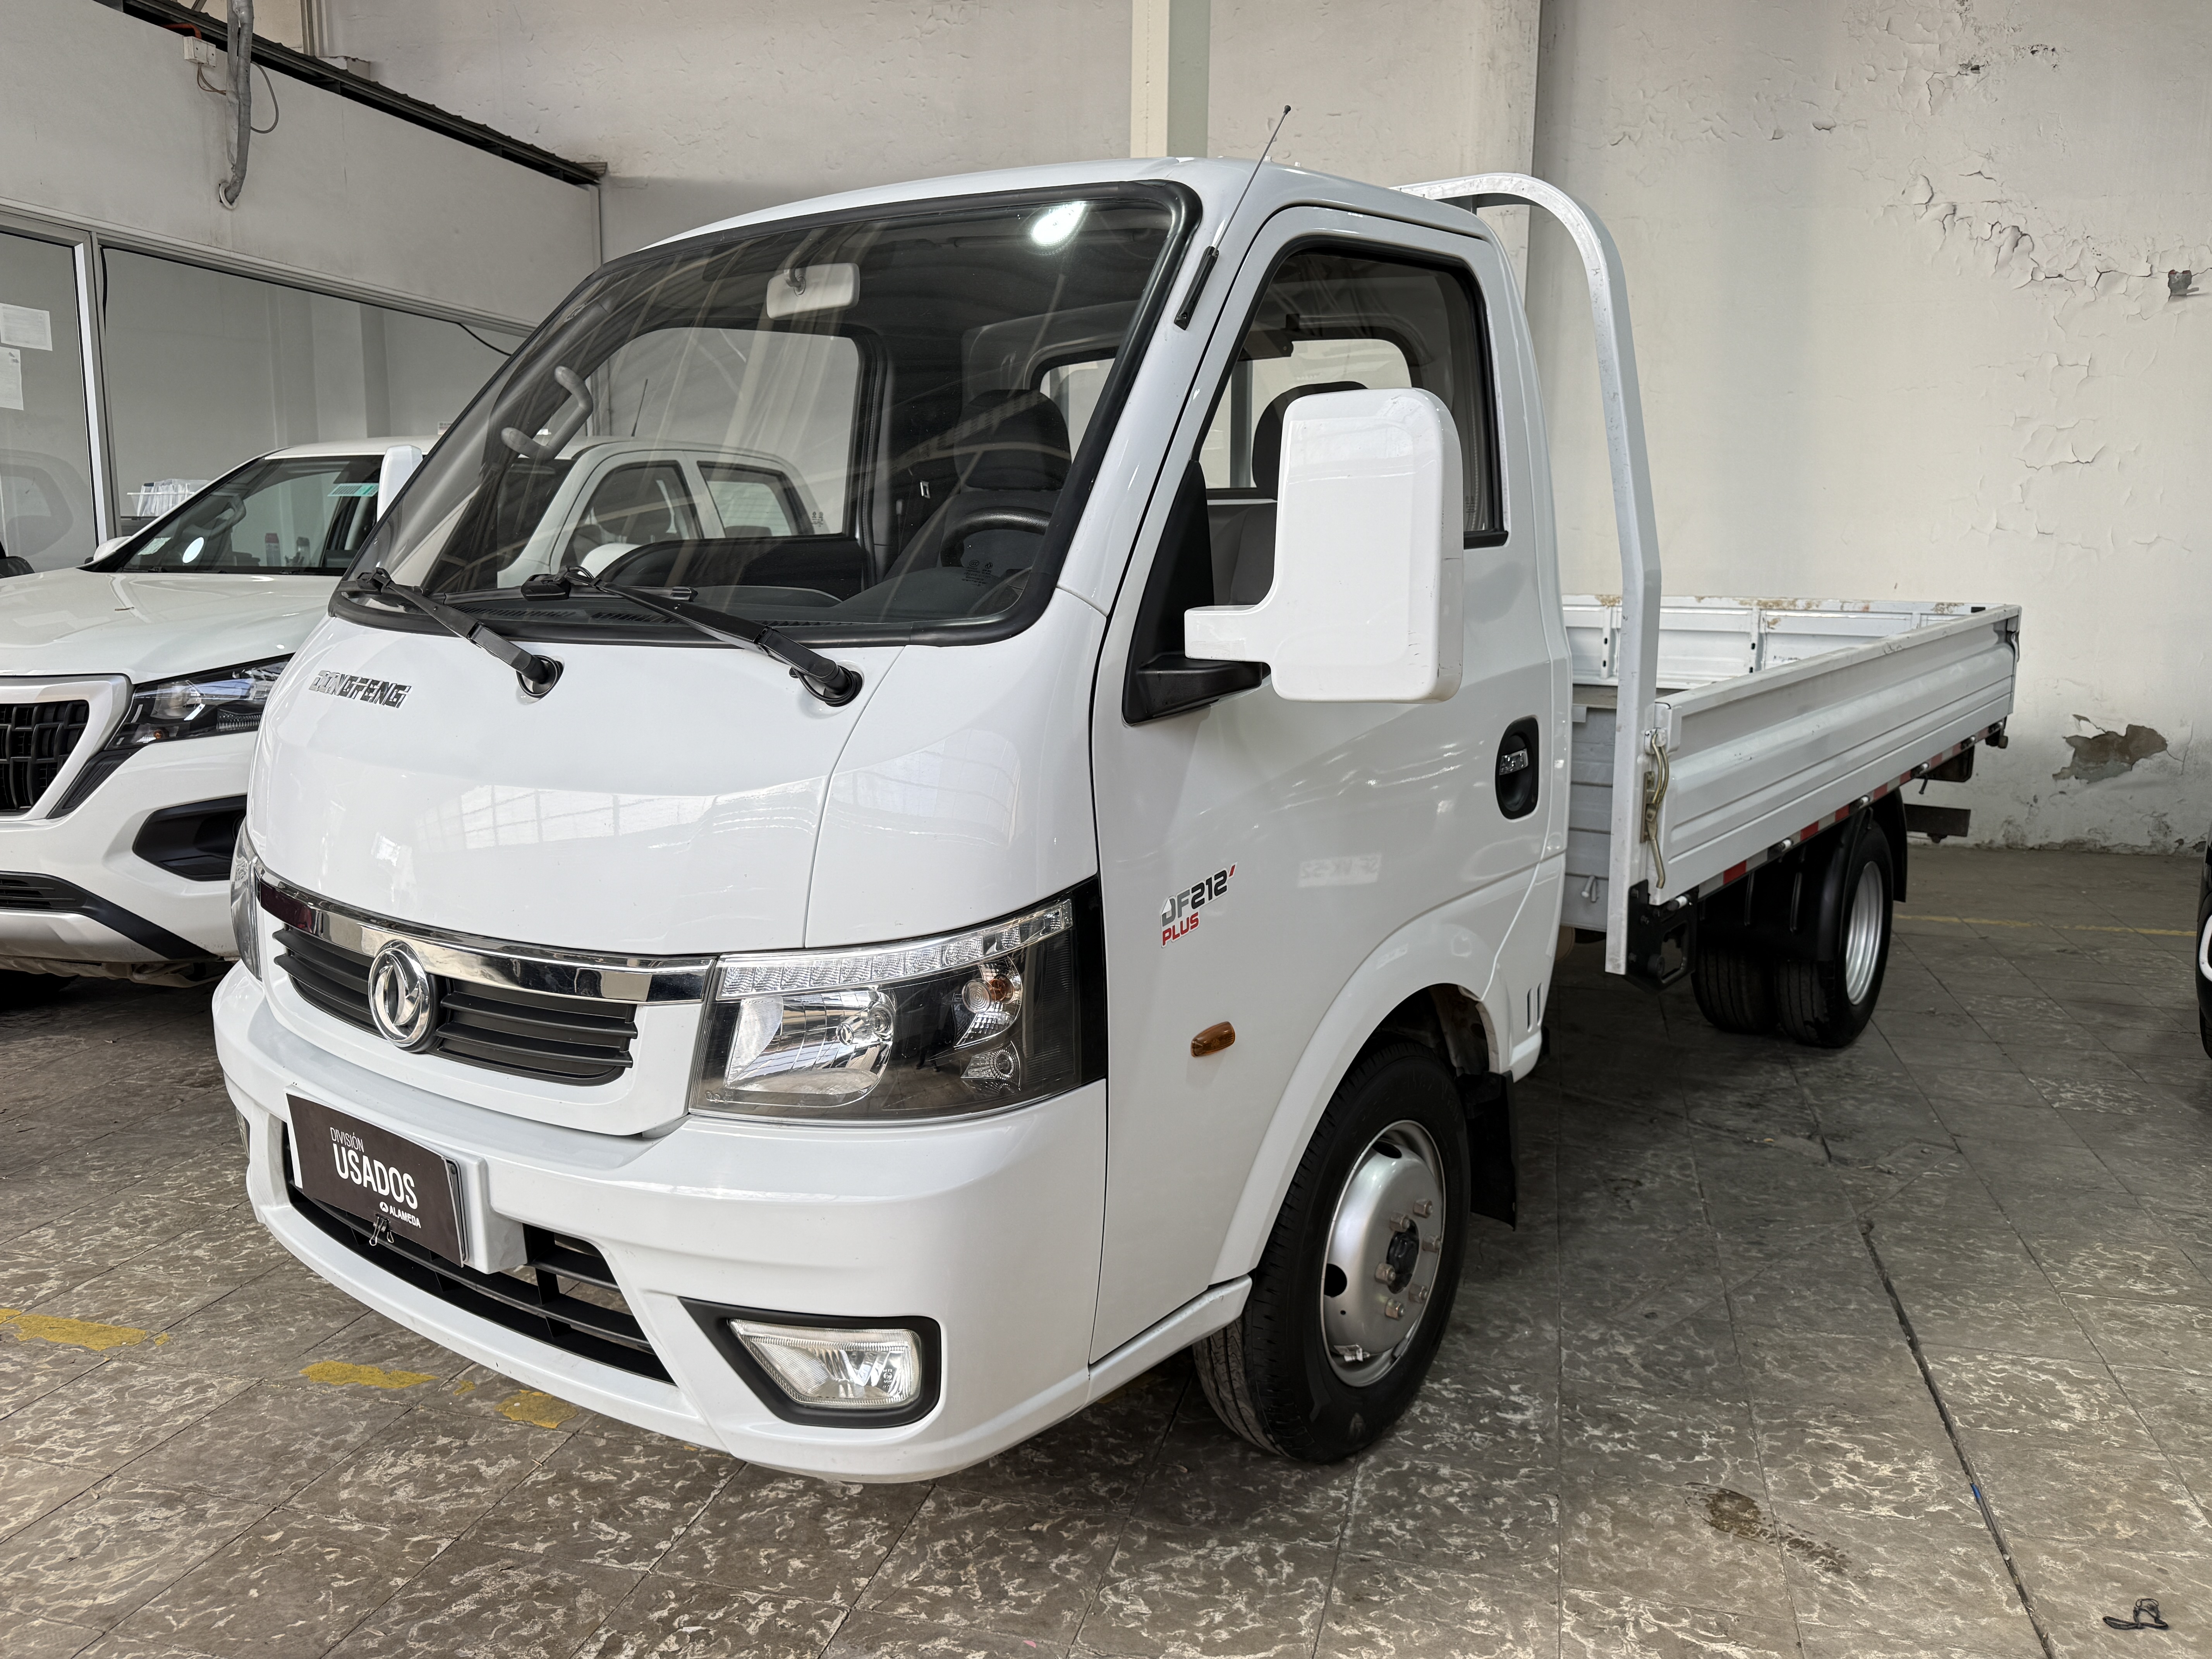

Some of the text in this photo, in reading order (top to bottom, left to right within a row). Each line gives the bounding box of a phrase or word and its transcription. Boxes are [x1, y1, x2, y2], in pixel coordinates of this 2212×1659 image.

[1162, 912, 1199, 946] PLUS
[330, 1127, 364, 1152] DIVISIÓN
[333, 1144, 418, 1209] USADOS
[390, 1205, 421, 1228] ALAMEDA
